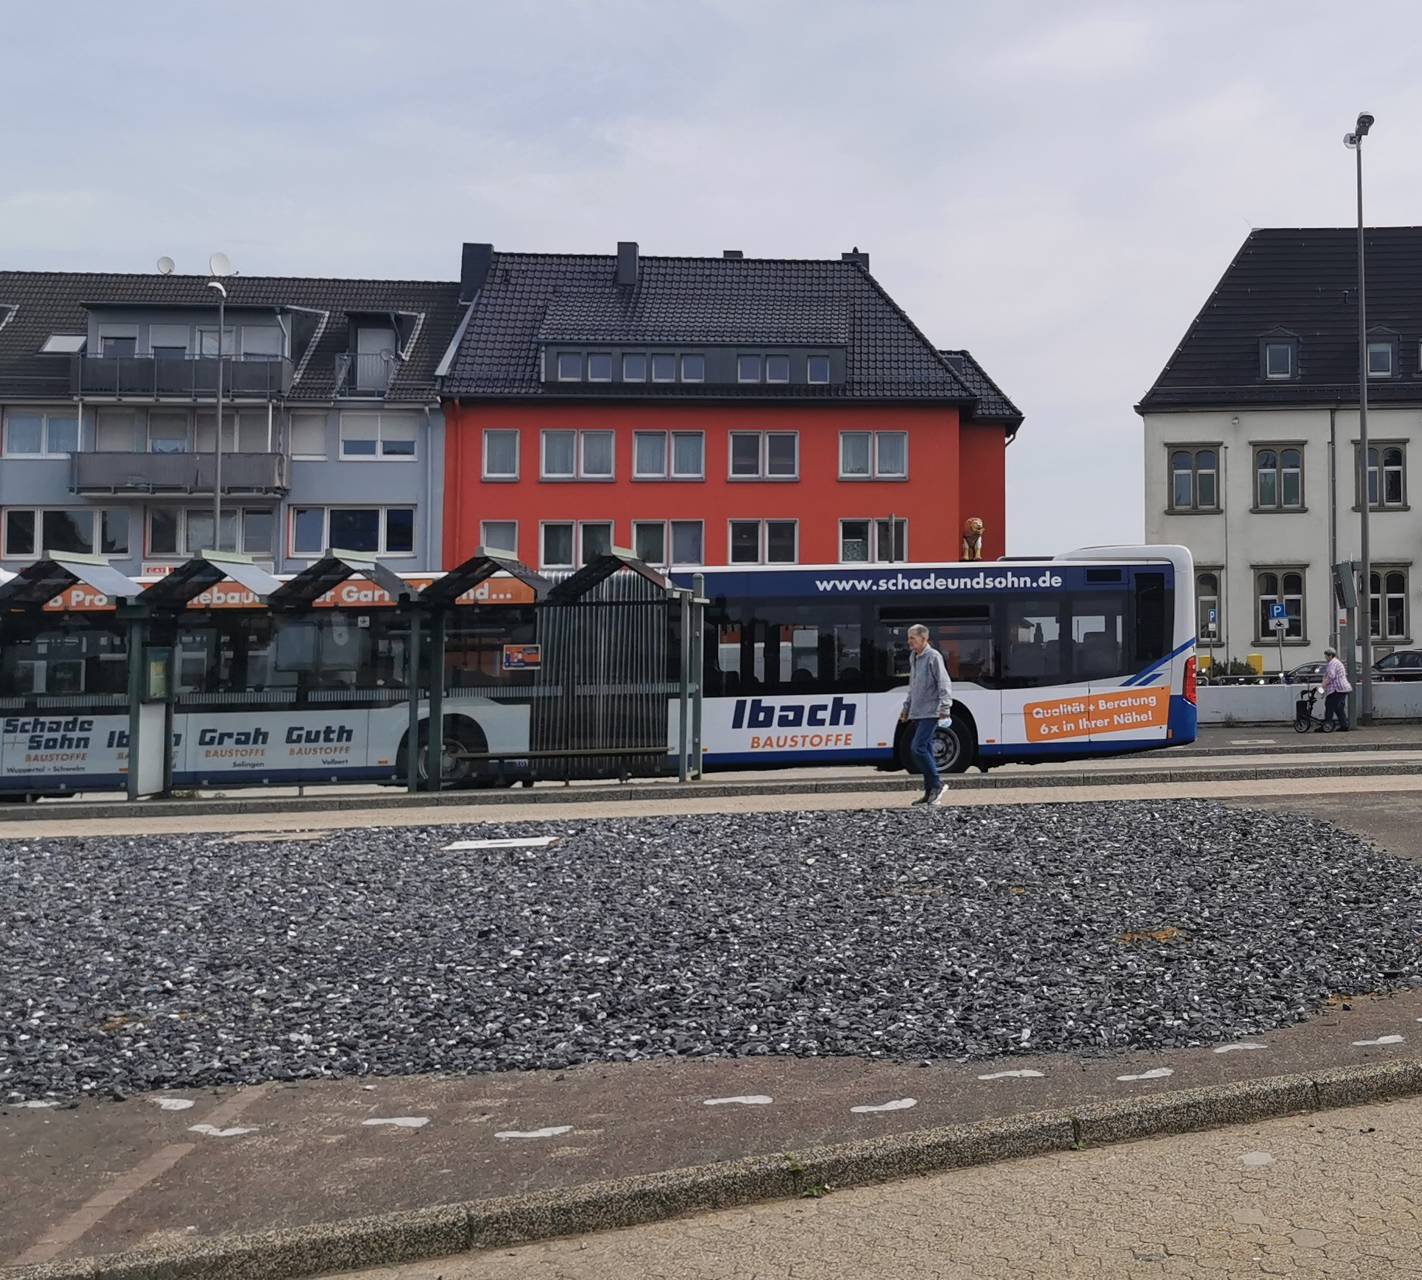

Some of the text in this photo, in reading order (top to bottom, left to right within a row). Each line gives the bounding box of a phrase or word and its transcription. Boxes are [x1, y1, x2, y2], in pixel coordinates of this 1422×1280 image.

[815, 571, 1063, 591] www.schadeundsohn.de
[1273, 605, 1282, 616] P
[732, 697, 857, 729] Ibach
[1032, 702, 1086, 719] Qualität
[1098, 695, 1157, 711] Beratung
[3, 717, 94, 733] Schade
[1040, 710, 1153, 735] 6x in Ihrer Nähe!
[28, 734, 91, 750] Sohn
[199, 728, 269, 746] Grah
[285, 725, 353, 744] Guth
[751, 733, 853, 749] BAUSTOFFE
[25, 752, 88, 762] BAUSTOFFE
[205, 748, 266, 758] BAUSTOFFE
[289, 746, 351, 756] BAUSTOFFE
